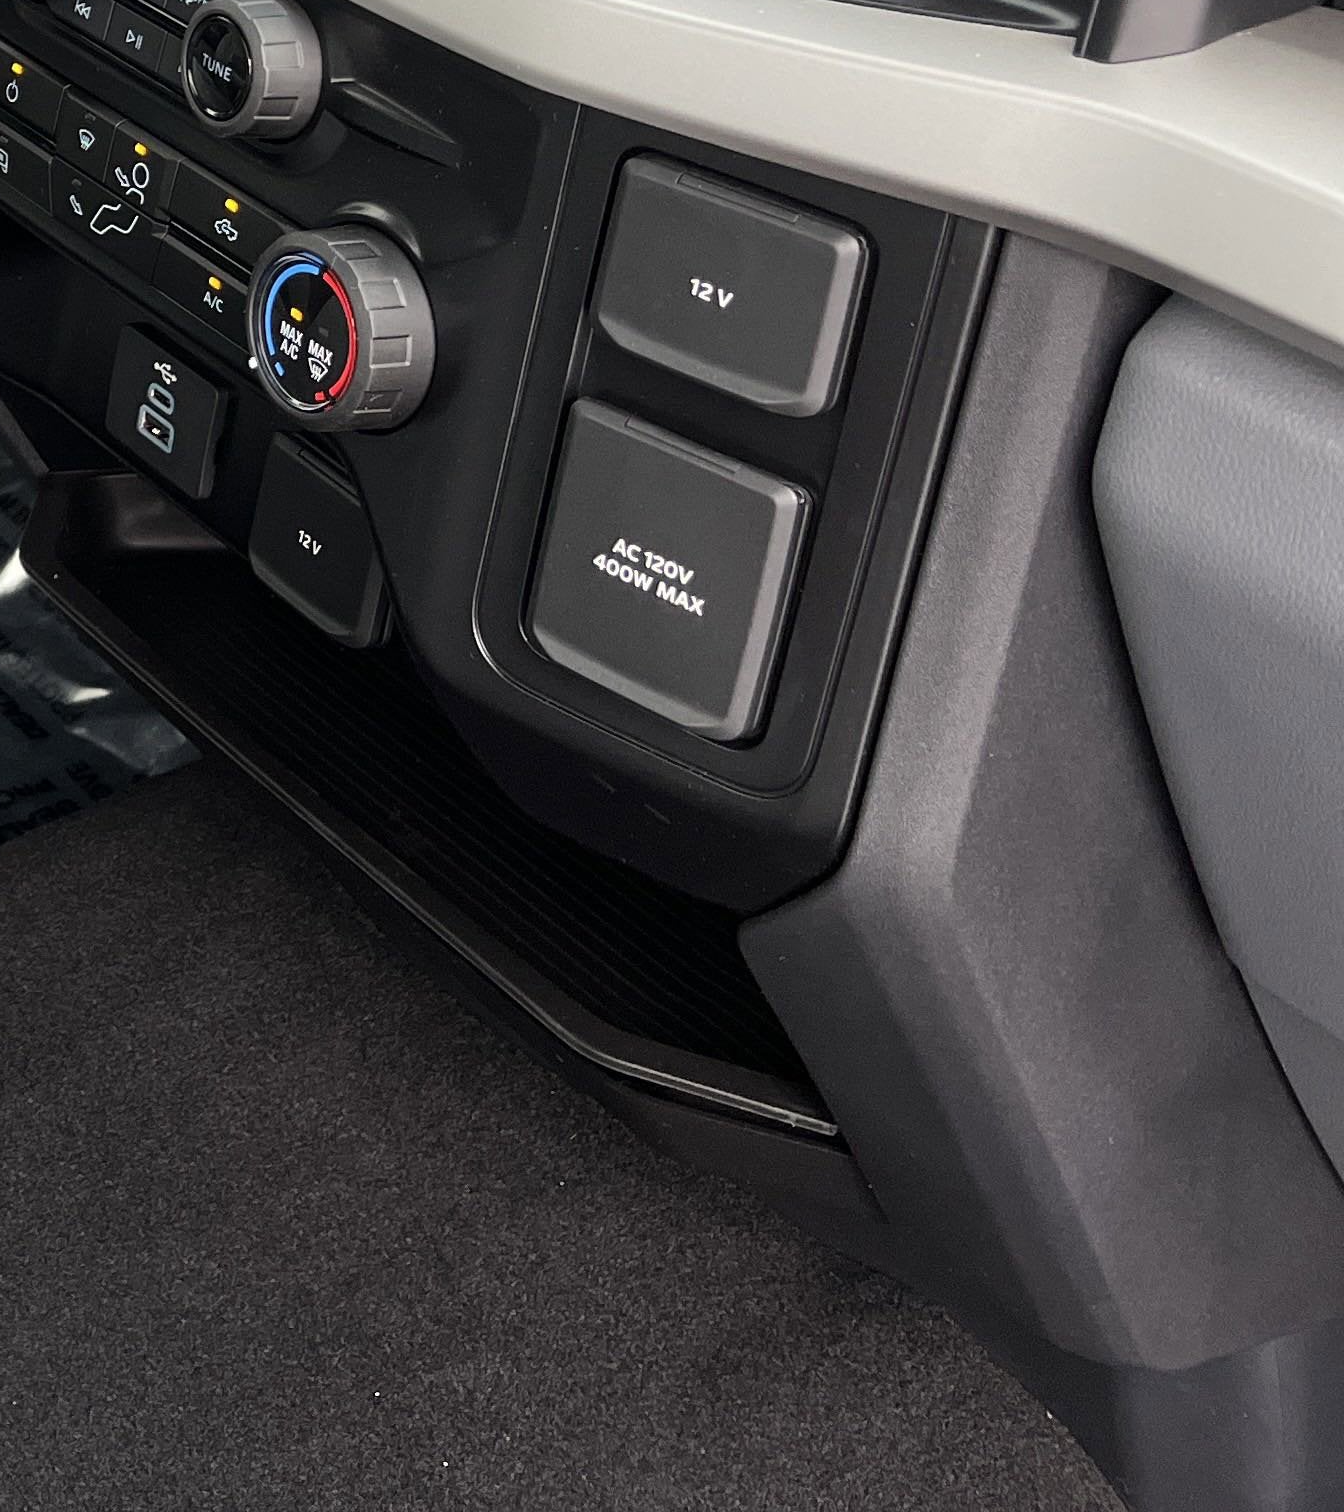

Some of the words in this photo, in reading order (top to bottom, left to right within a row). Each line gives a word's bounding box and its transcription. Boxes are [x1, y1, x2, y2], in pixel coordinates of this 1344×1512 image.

[202, 52, 232, 82] TUNE
[203, 291, 224, 313] A/C
[279, 320, 304, 347] MAX
[279, 339, 299, 361] A/C
[308, 339, 334, 367] MAX
[611, 538, 642, 563] AC
[643, 551, 695, 585] 120V
[592, 554, 654, 592] 400W
[655, 581, 705, 617] MAX
